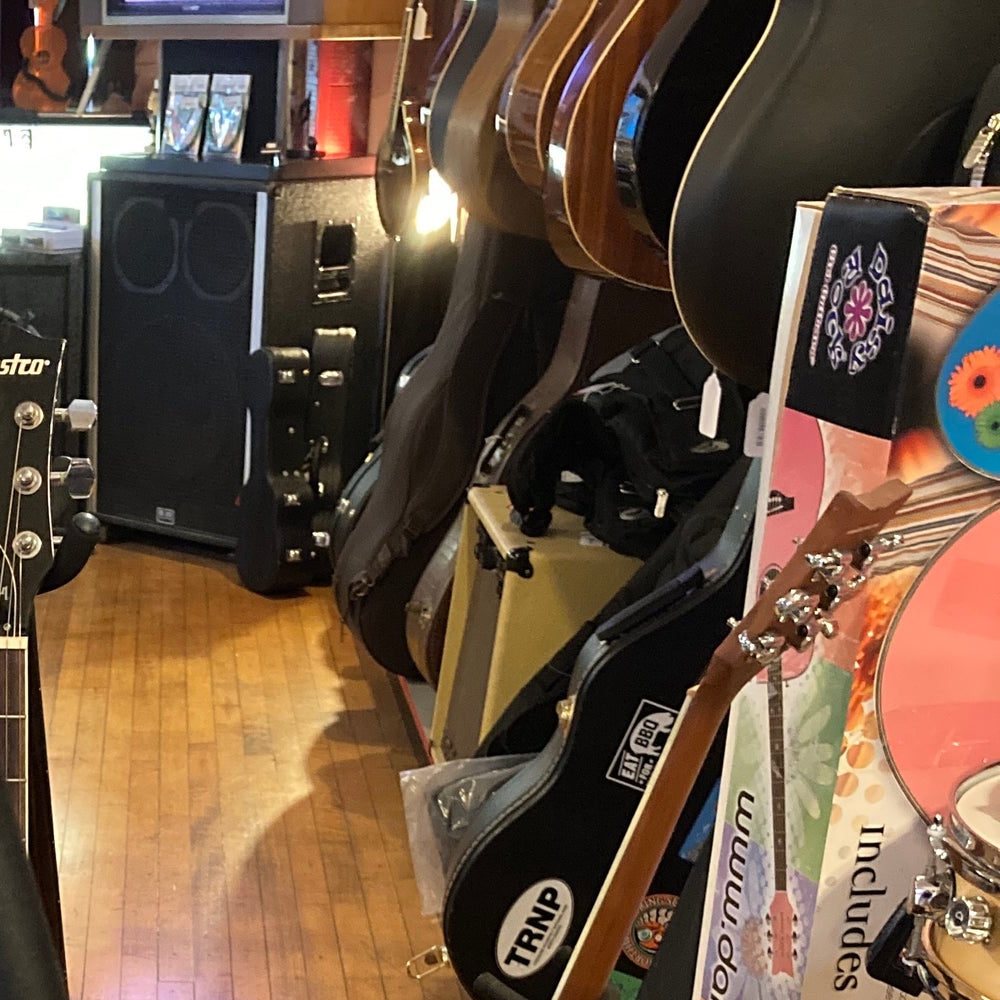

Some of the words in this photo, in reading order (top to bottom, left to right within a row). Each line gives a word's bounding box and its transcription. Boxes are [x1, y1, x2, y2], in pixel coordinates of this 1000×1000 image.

[621, 752, 640, 780] EAT
[503, 886, 560, 967] TRNP
[833, 823, 888, 992] Includes
